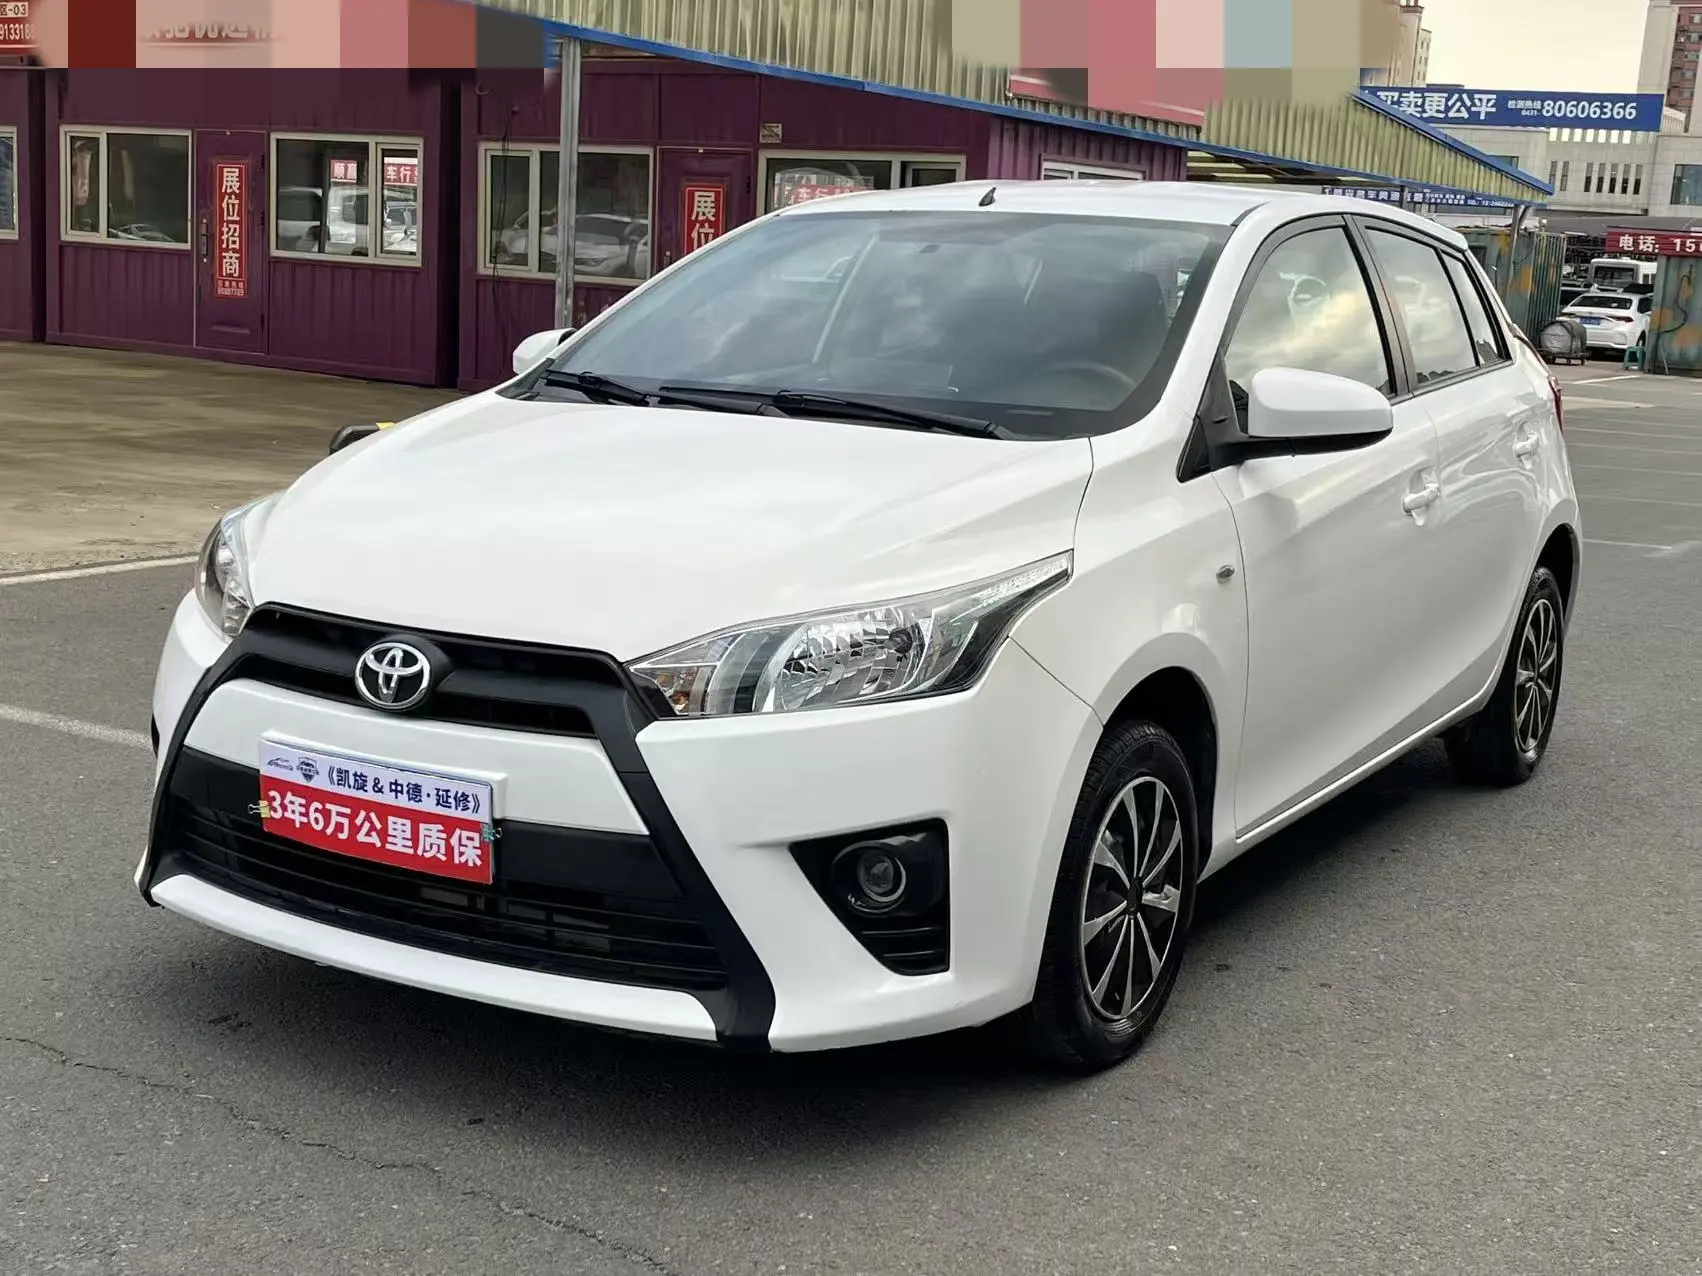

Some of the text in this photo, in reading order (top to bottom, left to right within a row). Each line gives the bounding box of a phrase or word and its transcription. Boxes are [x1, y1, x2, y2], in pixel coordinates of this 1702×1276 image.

[1542, 100, 1637, 119] 80606366
[221, 168, 241, 277] 展位招商
[691, 191, 717, 251] 展位
[1673, 237, 1702, 252] 15
[268, 790, 483, 867] 3年6万公里质保
